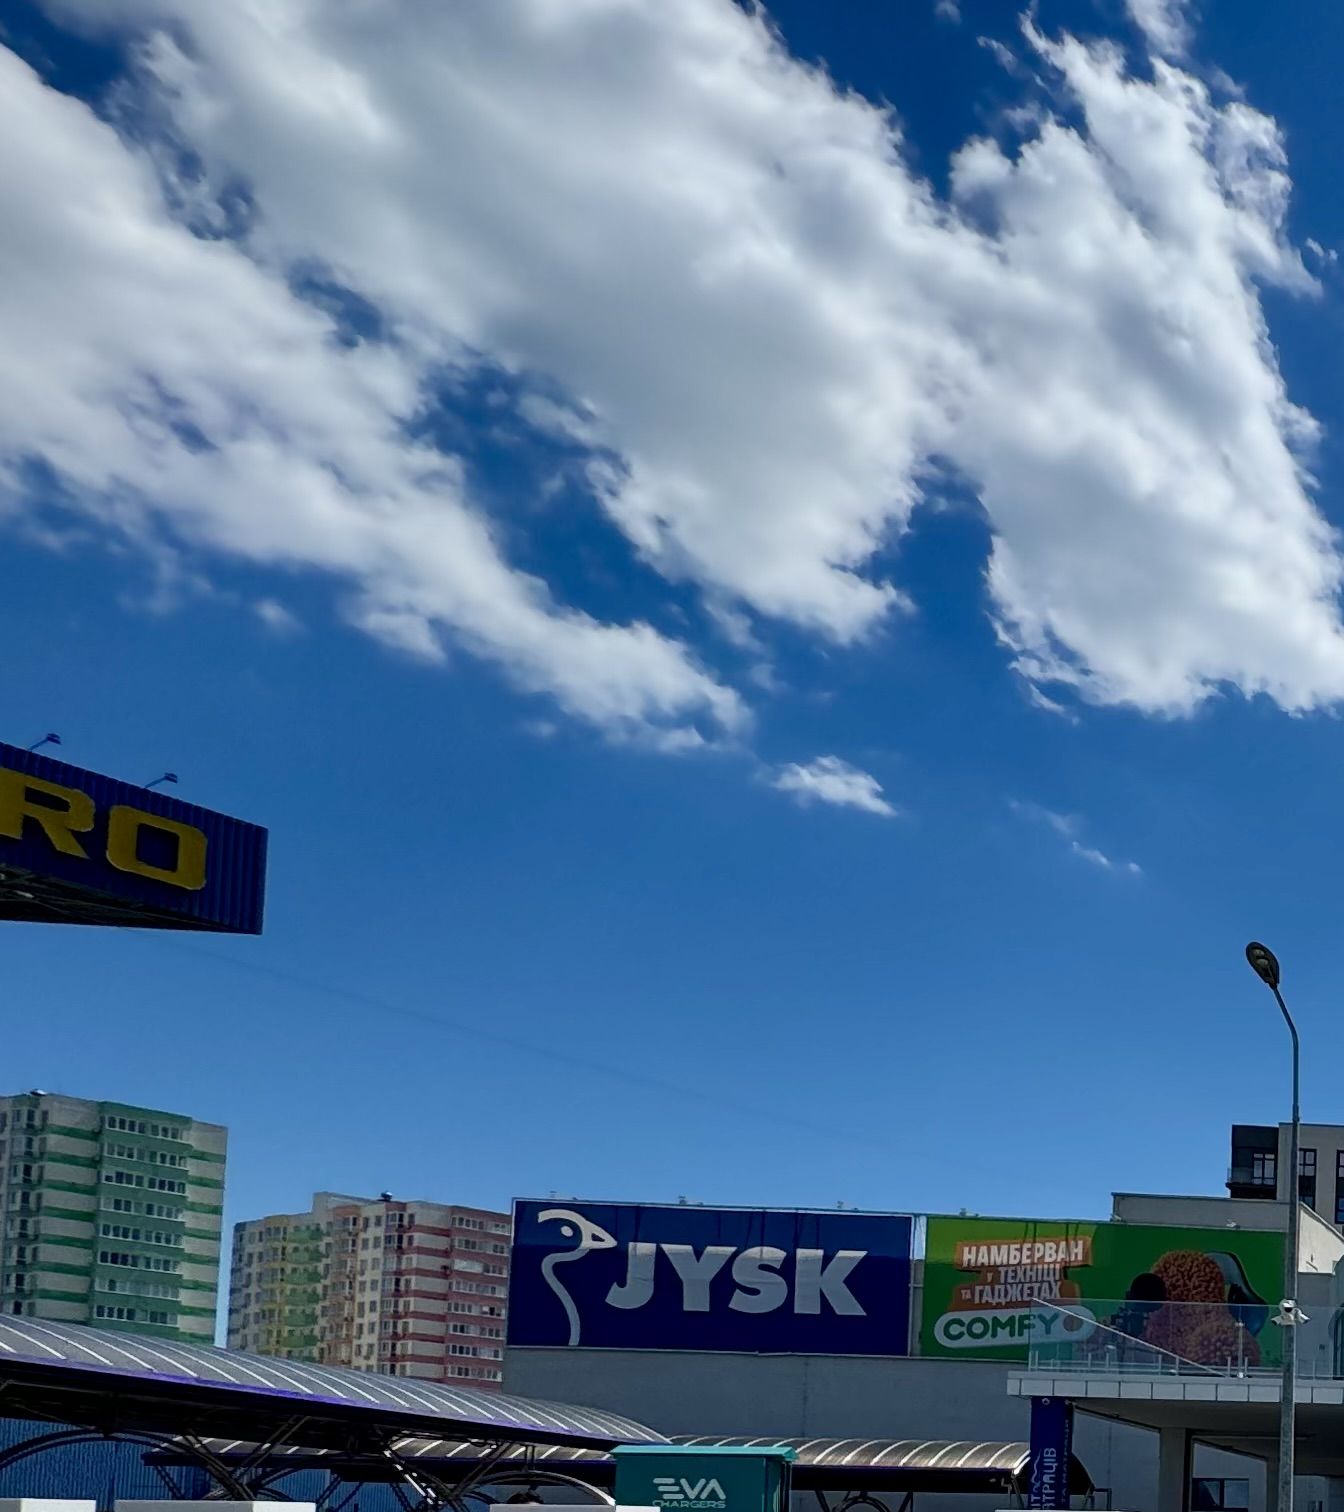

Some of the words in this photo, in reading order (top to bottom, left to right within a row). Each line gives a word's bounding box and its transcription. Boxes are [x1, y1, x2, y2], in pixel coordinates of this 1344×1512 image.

[962, 1240, 1084, 1268] НАМБЕРВАН
[605, 1242, 868, 1316] JYSK
[997, 1263, 1060, 1283] ТЕХНІЦІ
[974, 1281, 1061, 1305] ГАДЖЕТАХ
[943, 1313, 1060, 1341] COMFY
[653, 1478, 727, 1500] EVA
[1042, 1447, 1058, 1510] АТРАЦІВ
[652, 1499, 726, 1509] CHARGERS
